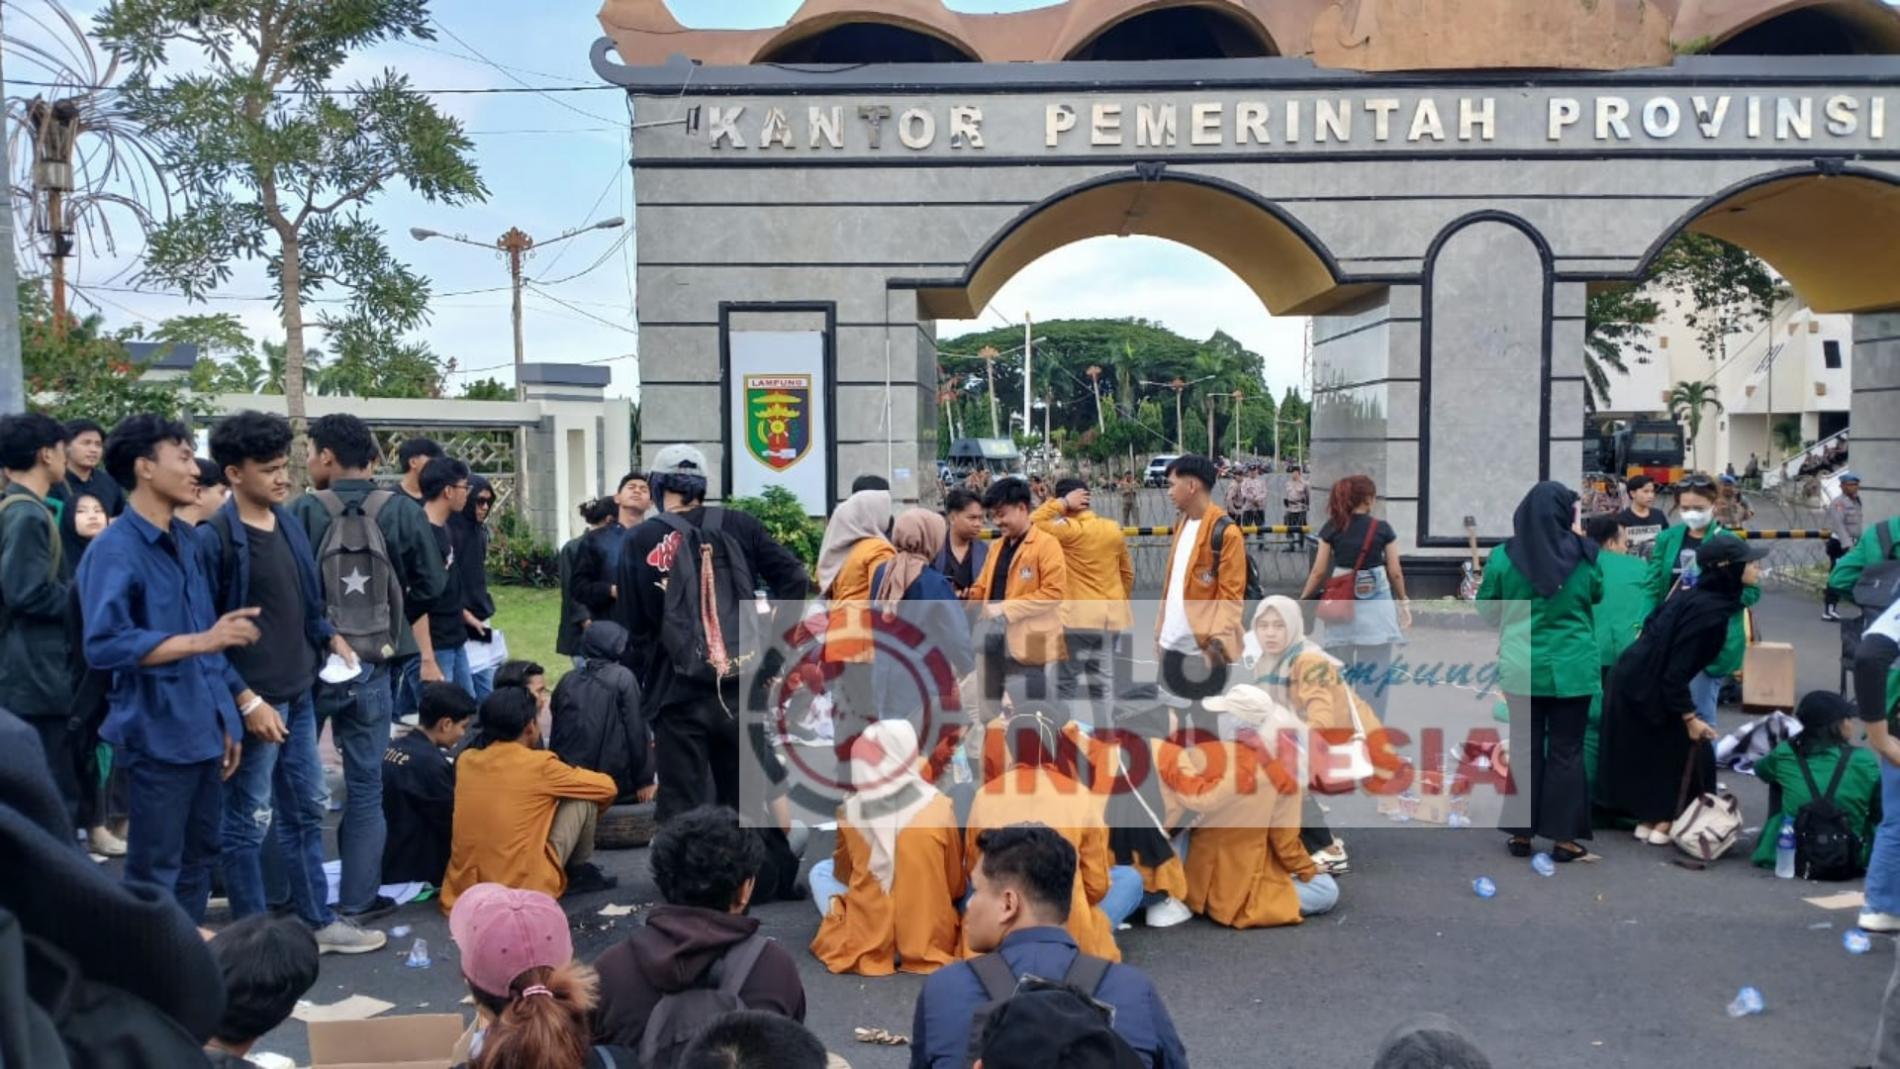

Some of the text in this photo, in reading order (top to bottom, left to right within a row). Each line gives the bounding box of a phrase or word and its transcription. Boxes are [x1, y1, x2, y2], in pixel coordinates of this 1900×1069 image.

[708, 94, 1884, 150] KANTOR PEMERINTAH PROVINSI
[751, 379, 803, 387] LAMPUNG
